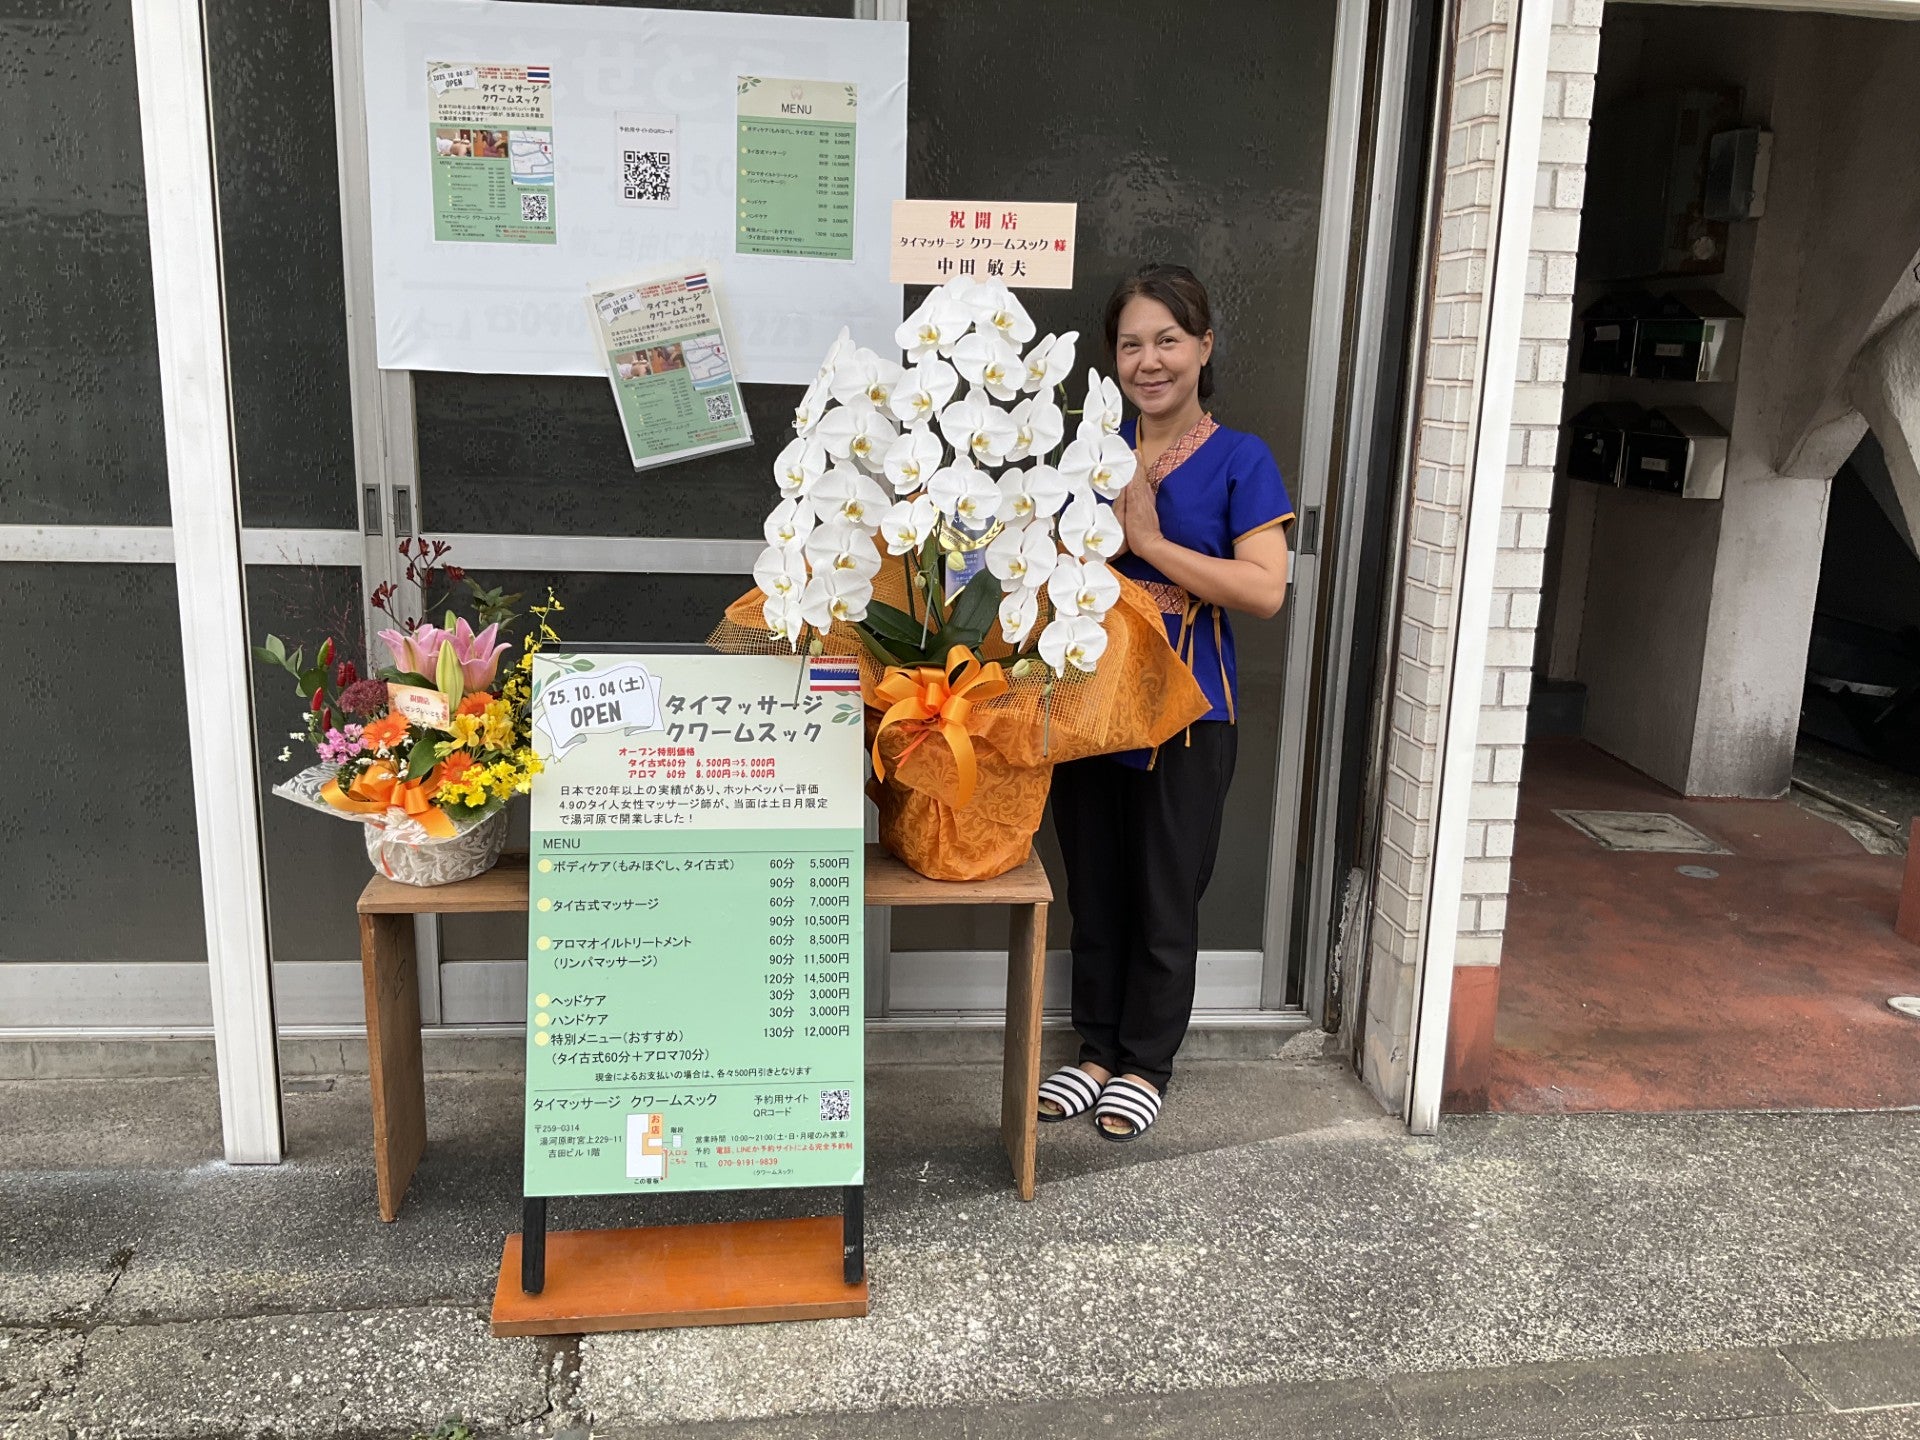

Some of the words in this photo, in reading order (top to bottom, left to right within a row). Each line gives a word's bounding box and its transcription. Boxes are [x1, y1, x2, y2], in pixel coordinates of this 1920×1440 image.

[445, 78, 463, 88] OPEN
[482, 84, 540, 93] タイマッサージ
[482, 94, 540, 104] クワームスック
[781, 103, 813, 115] MENU
[950, 211, 1018, 230] 祝開店
[900, 237, 965, 249] タイマッサージ
[970, 237, 1049, 251] クワームスック
[1054, 239, 1067, 252] 様
[647, 294, 701, 310] タイマッサージ
[613, 304, 628, 315] OPEN
[650, 303, 703, 320] クワームスック
[665, 694, 823, 715] タイマッサージ
[570, 700, 622, 729] OPEN
[666, 721, 822, 743] クワームスック
[618, 747, 695, 757] オープン特別価格
[628, 758, 686, 768] タイ古式60分
[628, 769, 657, 779] アロマ
[666, 769, 686, 779] 60分
[560, 783, 819, 797] 日本で20年以上の実績があり、ホットペッパー評価
[559, 797, 828, 810] 4.9のタイ人女性マッサージ師が、当面は土日月限定
[559, 813, 693, 825] で湯河原で開業しました！
[543, 838, 581, 849] MENU
[553, 858, 735, 873] ボディケア（もみほぐし、タイ古式）
[770, 858, 795, 870] 60分
[809, 858, 849, 870] 5,500円
[770, 877, 795, 889] 90分
[809, 877, 849, 889] 8,000円
[553, 898, 659, 912] タイ古式マッサージ
[770, 896, 795, 908] 60分
[809, 896, 849, 908] 7,000円
[770, 915, 795, 927] 90分
[804, 915, 849, 927] 10,500円
[552, 936, 692, 950] アロマオイルトリートメント
[770, 934, 795, 946] 60分
[809, 934, 849, 946] 8,500円
[553, 955, 658, 970] （リンパマッサージ）
[769, 953, 795, 965] 90分
[803, 953, 849, 965] 11,500円
[763, 973, 795, 985] 120分
[803, 972, 849, 984] 14,500円
[551, 994, 607, 1007] ヘッドケア
[769, 989, 795, 1001] 30分
[809, 988, 849, 1001] 3,000円
[551, 1013, 609, 1026] ハンドケア
[769, 1006, 795, 1019] 30分
[809, 1005, 849, 1018] 3,000円
[550, 1031, 684, 1046] 特別メニュー（おすすめ）
[763, 1026, 795, 1039] 130分
[803, 1025, 849, 1038] 12,000円
[551, 1050, 710, 1065] （タイ古式60分＋アロマ70分）
[594, 1067, 813, 1082] 現金によるお支払いの場合は、各々500円引きとなります
[533, 1096, 621, 1111] タイマッサージ
[630, 1092, 717, 1108] クワームスック
[754, 1094, 809, 1106] 予約用サイト
[753, 1107, 791, 1117] QRコード
[535, 1124, 580, 1133] 〒259-0314
[651, 1115, 660, 1134] お店
[539, 1135, 622, 1147] 湯河原町宮上229-11
[695, 1135, 726, 1144] 営業時間
[549, 1149, 582, 1158] 吉田ビル
